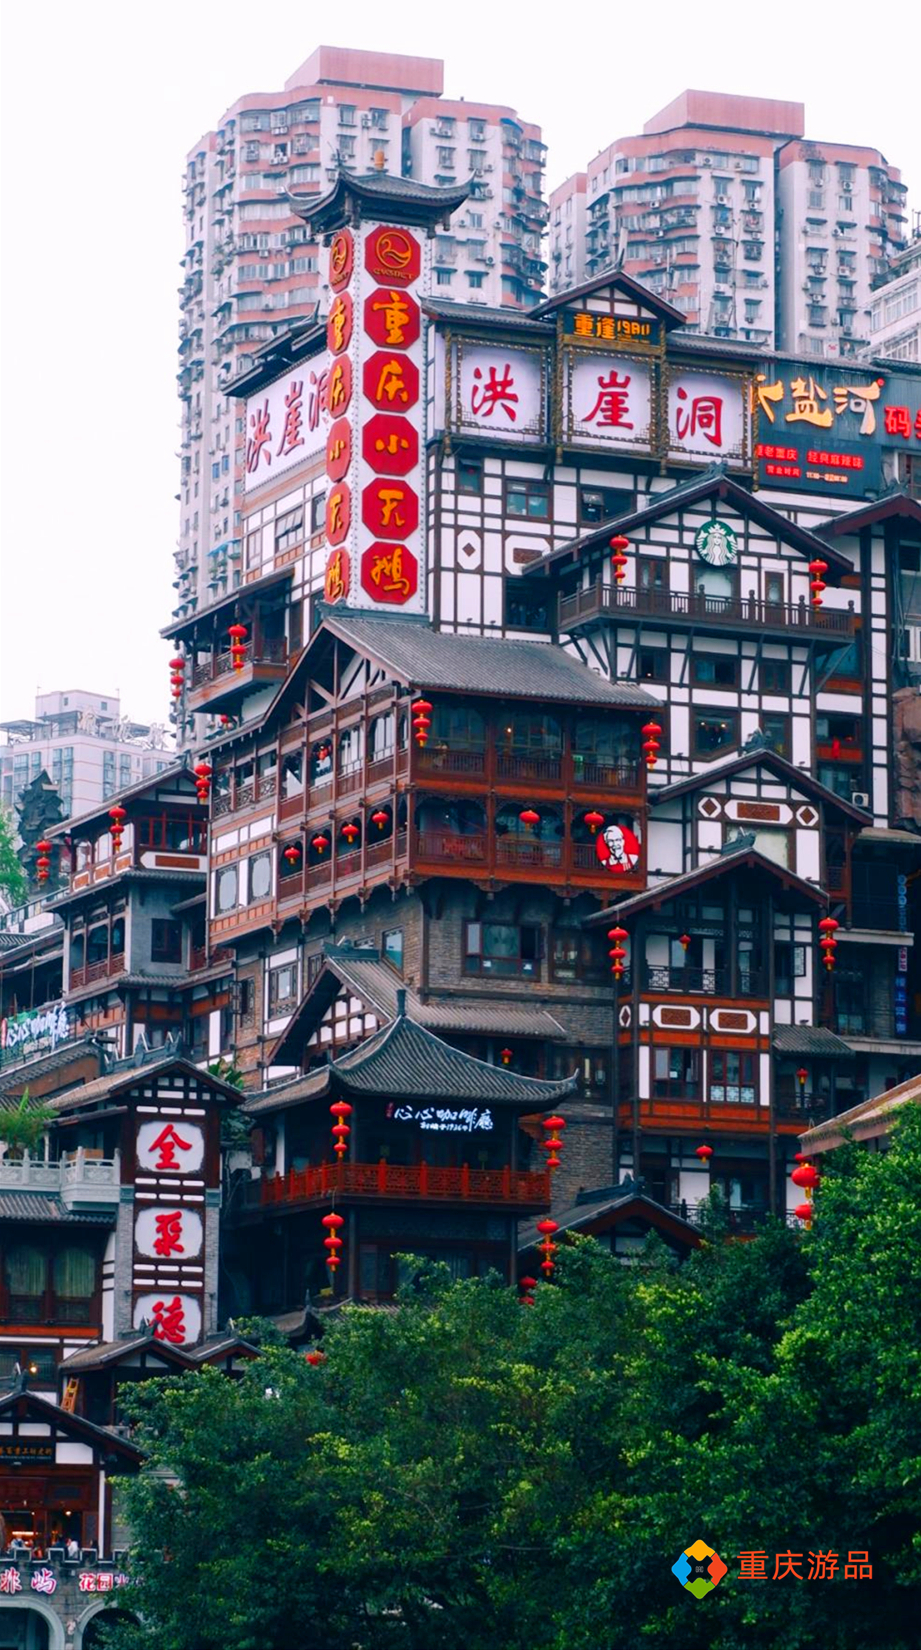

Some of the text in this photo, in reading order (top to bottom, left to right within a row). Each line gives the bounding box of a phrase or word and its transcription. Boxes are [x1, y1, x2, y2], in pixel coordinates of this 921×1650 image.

[371, 291, 411, 597] 重庆小天鹅
[470, 363, 724, 447] 洪崖洞
